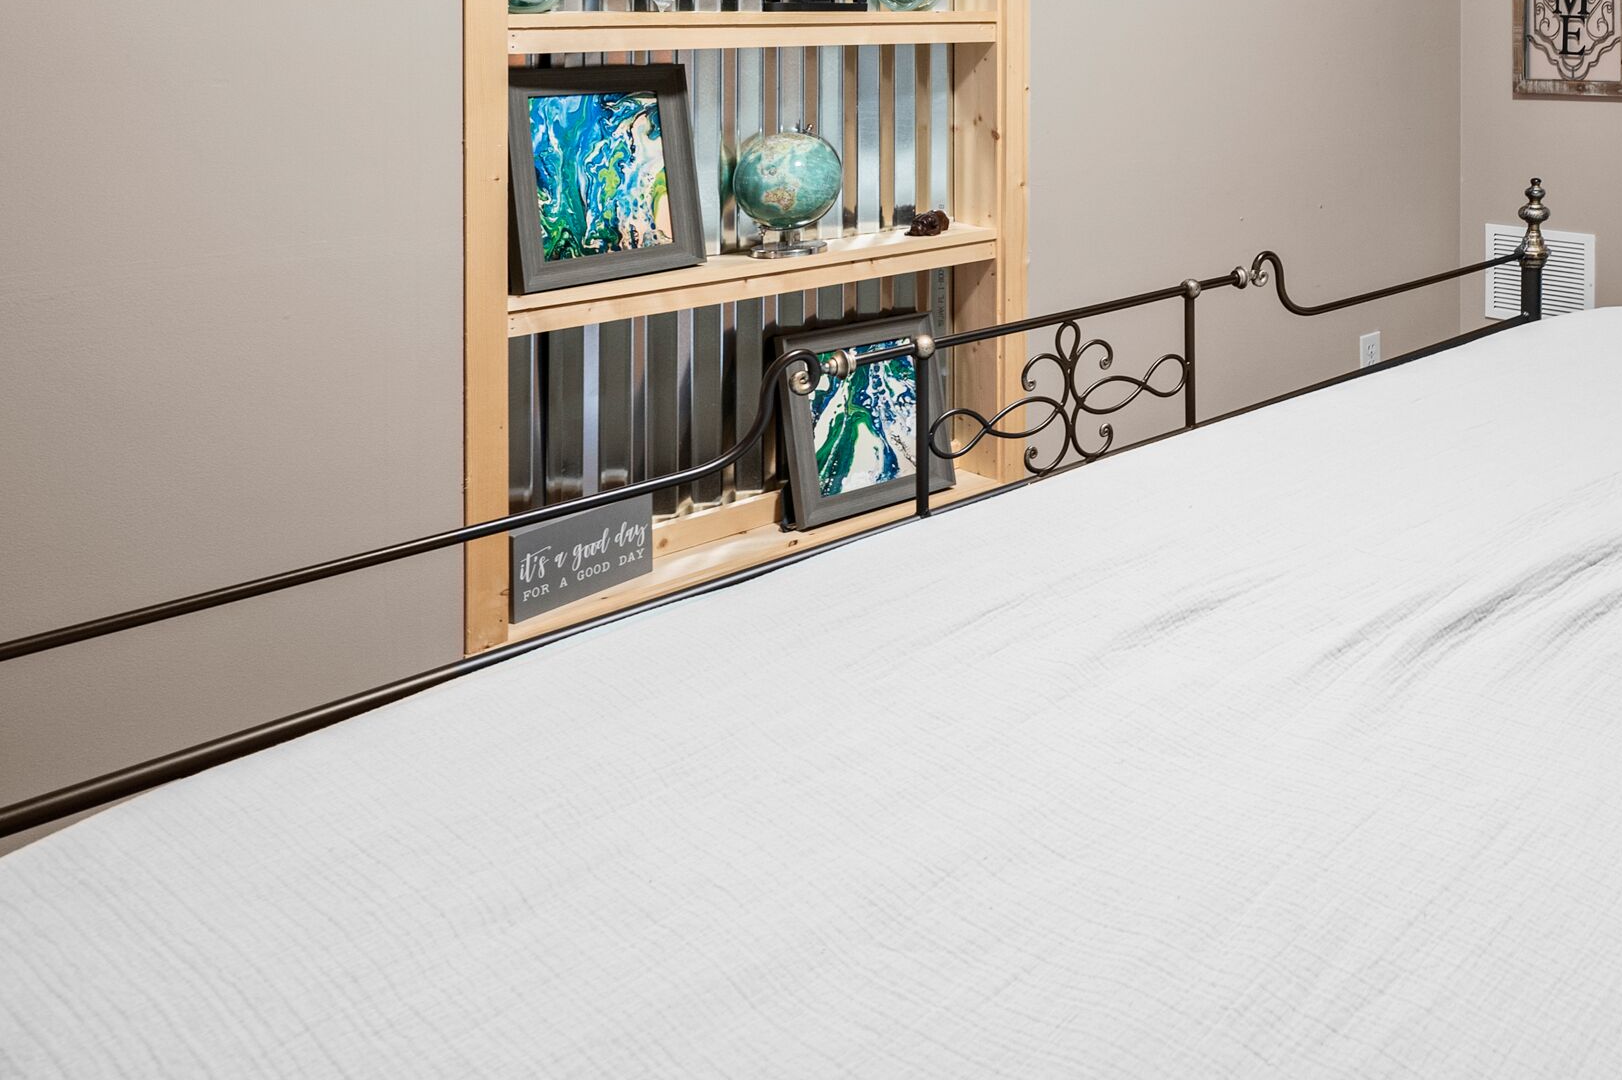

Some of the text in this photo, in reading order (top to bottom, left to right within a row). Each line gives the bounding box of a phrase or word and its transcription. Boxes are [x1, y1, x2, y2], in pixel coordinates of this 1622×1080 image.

[519, 521, 648, 583] it's a good day
[522, 548, 645, 602] FOR A GOOD DAY
